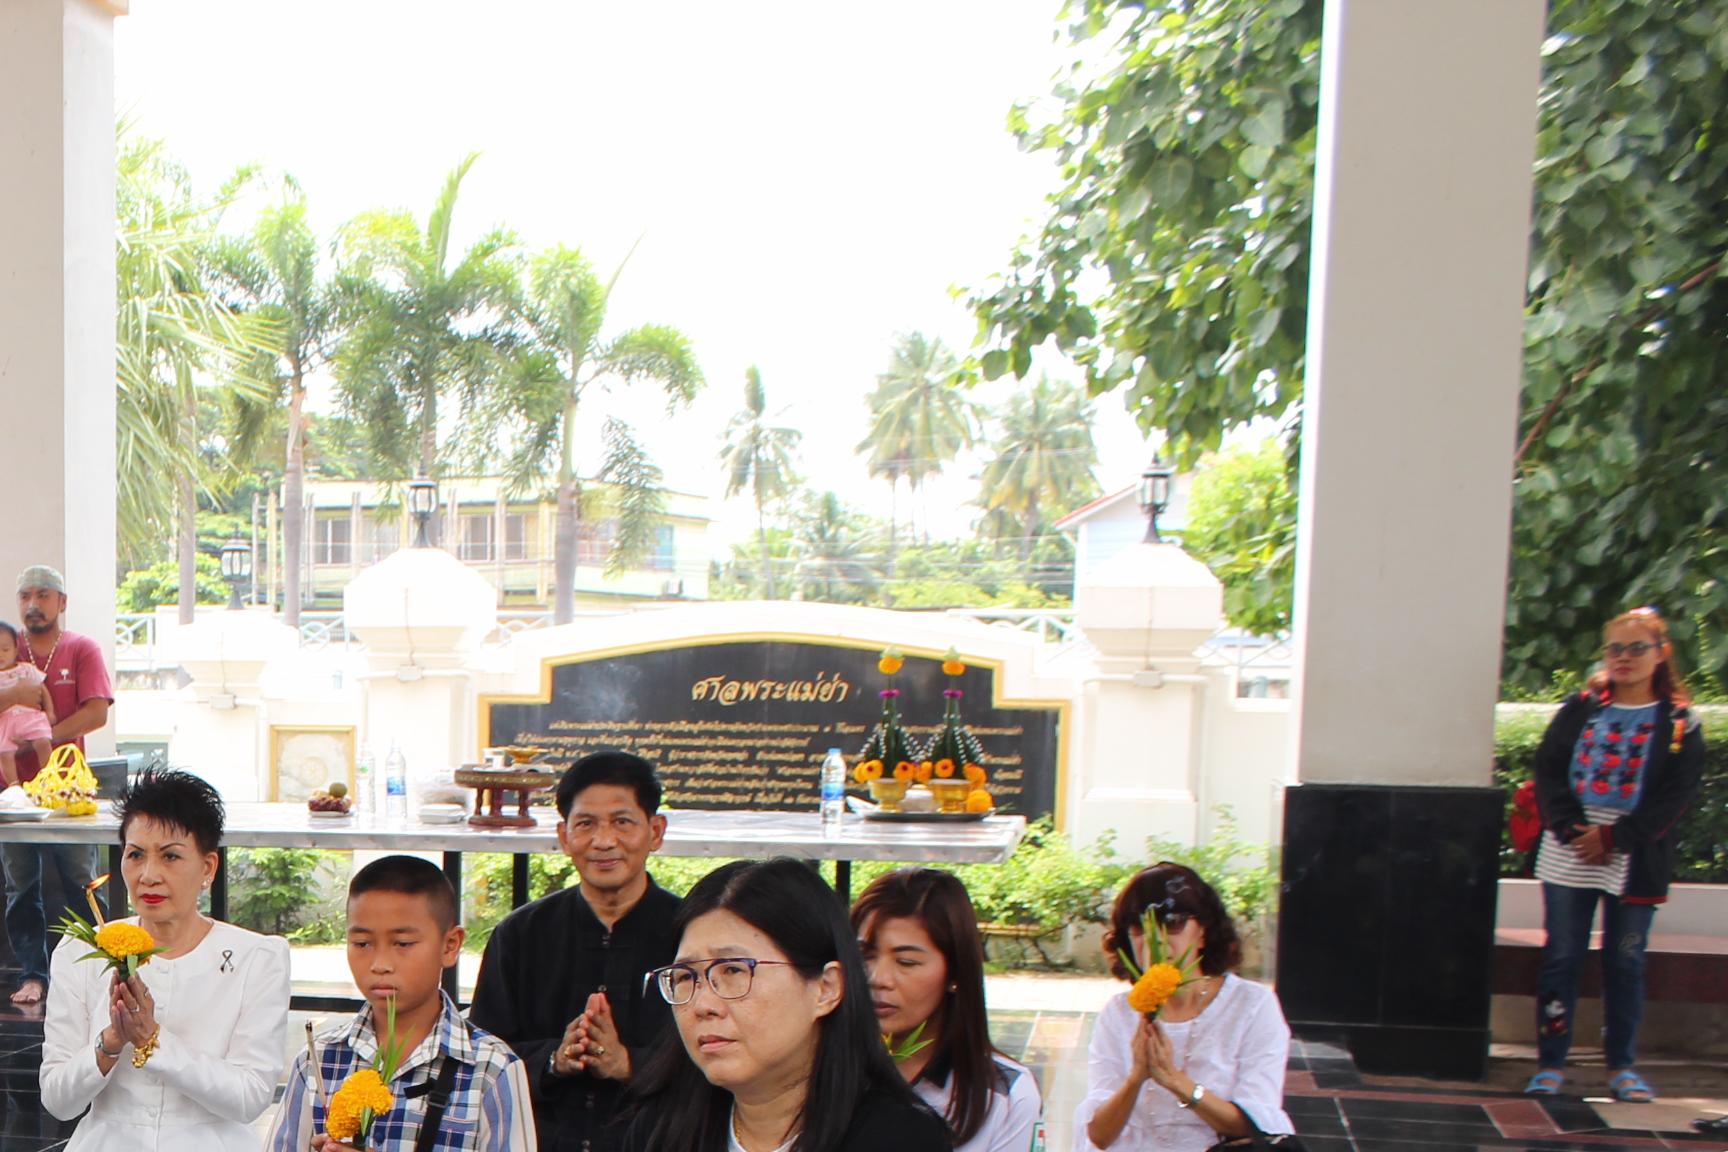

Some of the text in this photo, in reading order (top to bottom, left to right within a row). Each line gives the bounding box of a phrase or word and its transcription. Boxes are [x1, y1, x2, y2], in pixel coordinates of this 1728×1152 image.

[692, 671, 850, 706] ศาลพระแม่ย่า
